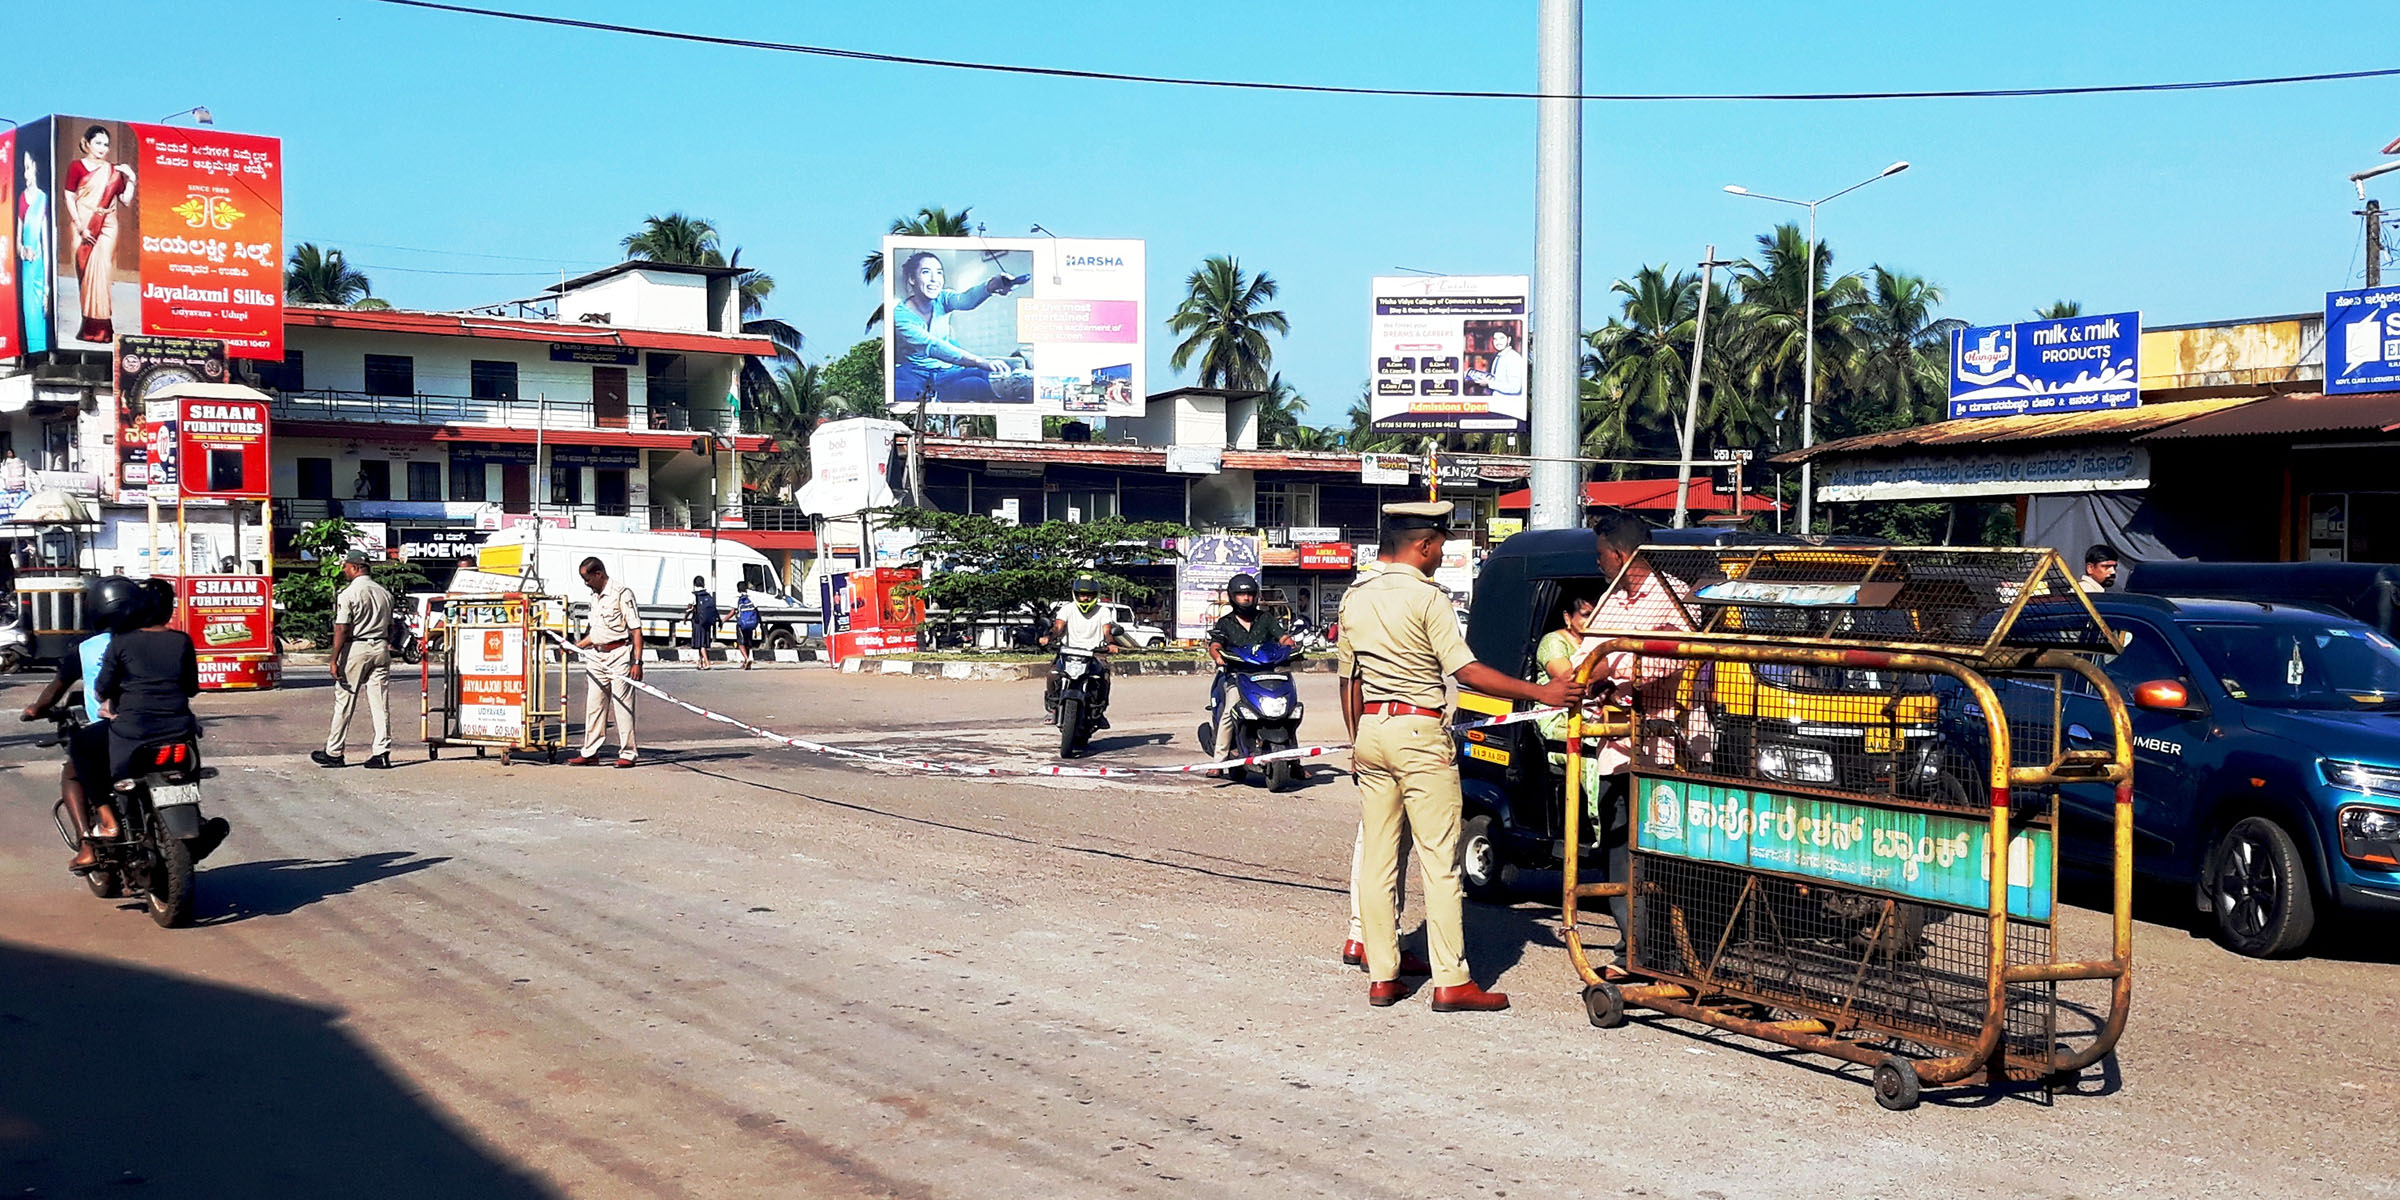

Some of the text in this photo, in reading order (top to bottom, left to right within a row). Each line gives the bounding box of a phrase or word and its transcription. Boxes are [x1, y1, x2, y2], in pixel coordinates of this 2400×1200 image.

[187, 184, 210, 193] SINCE
[143, 282, 275, 306] Jayalaxmi Silks
[1063, 303, 1092, 312] most
[1415, 298, 1436, 306] College
[221, 309, 248, 321] Udupi
[2033, 318, 2120, 346] milk & milk
[2042, 345, 2111, 364] PRODUCTS
[1410, 402, 1489, 413] Admissions Open
[2058, 397, 2065, 406] &
[189, 404, 256, 421] SHAAN
[183, 420, 264, 434] FURNITURES
[405, 542, 451, 558] SHOE
[195, 580, 258, 594] SHAAN
[189, 595, 264, 607] FURNITURES
[198, 662, 242, 672] DRINK
[478, 707, 506, 716] UDYAVARA
[462, 724, 520, 737] GO SLOW GO SLOW
[2133, 735, 2182, 756] IMBER
